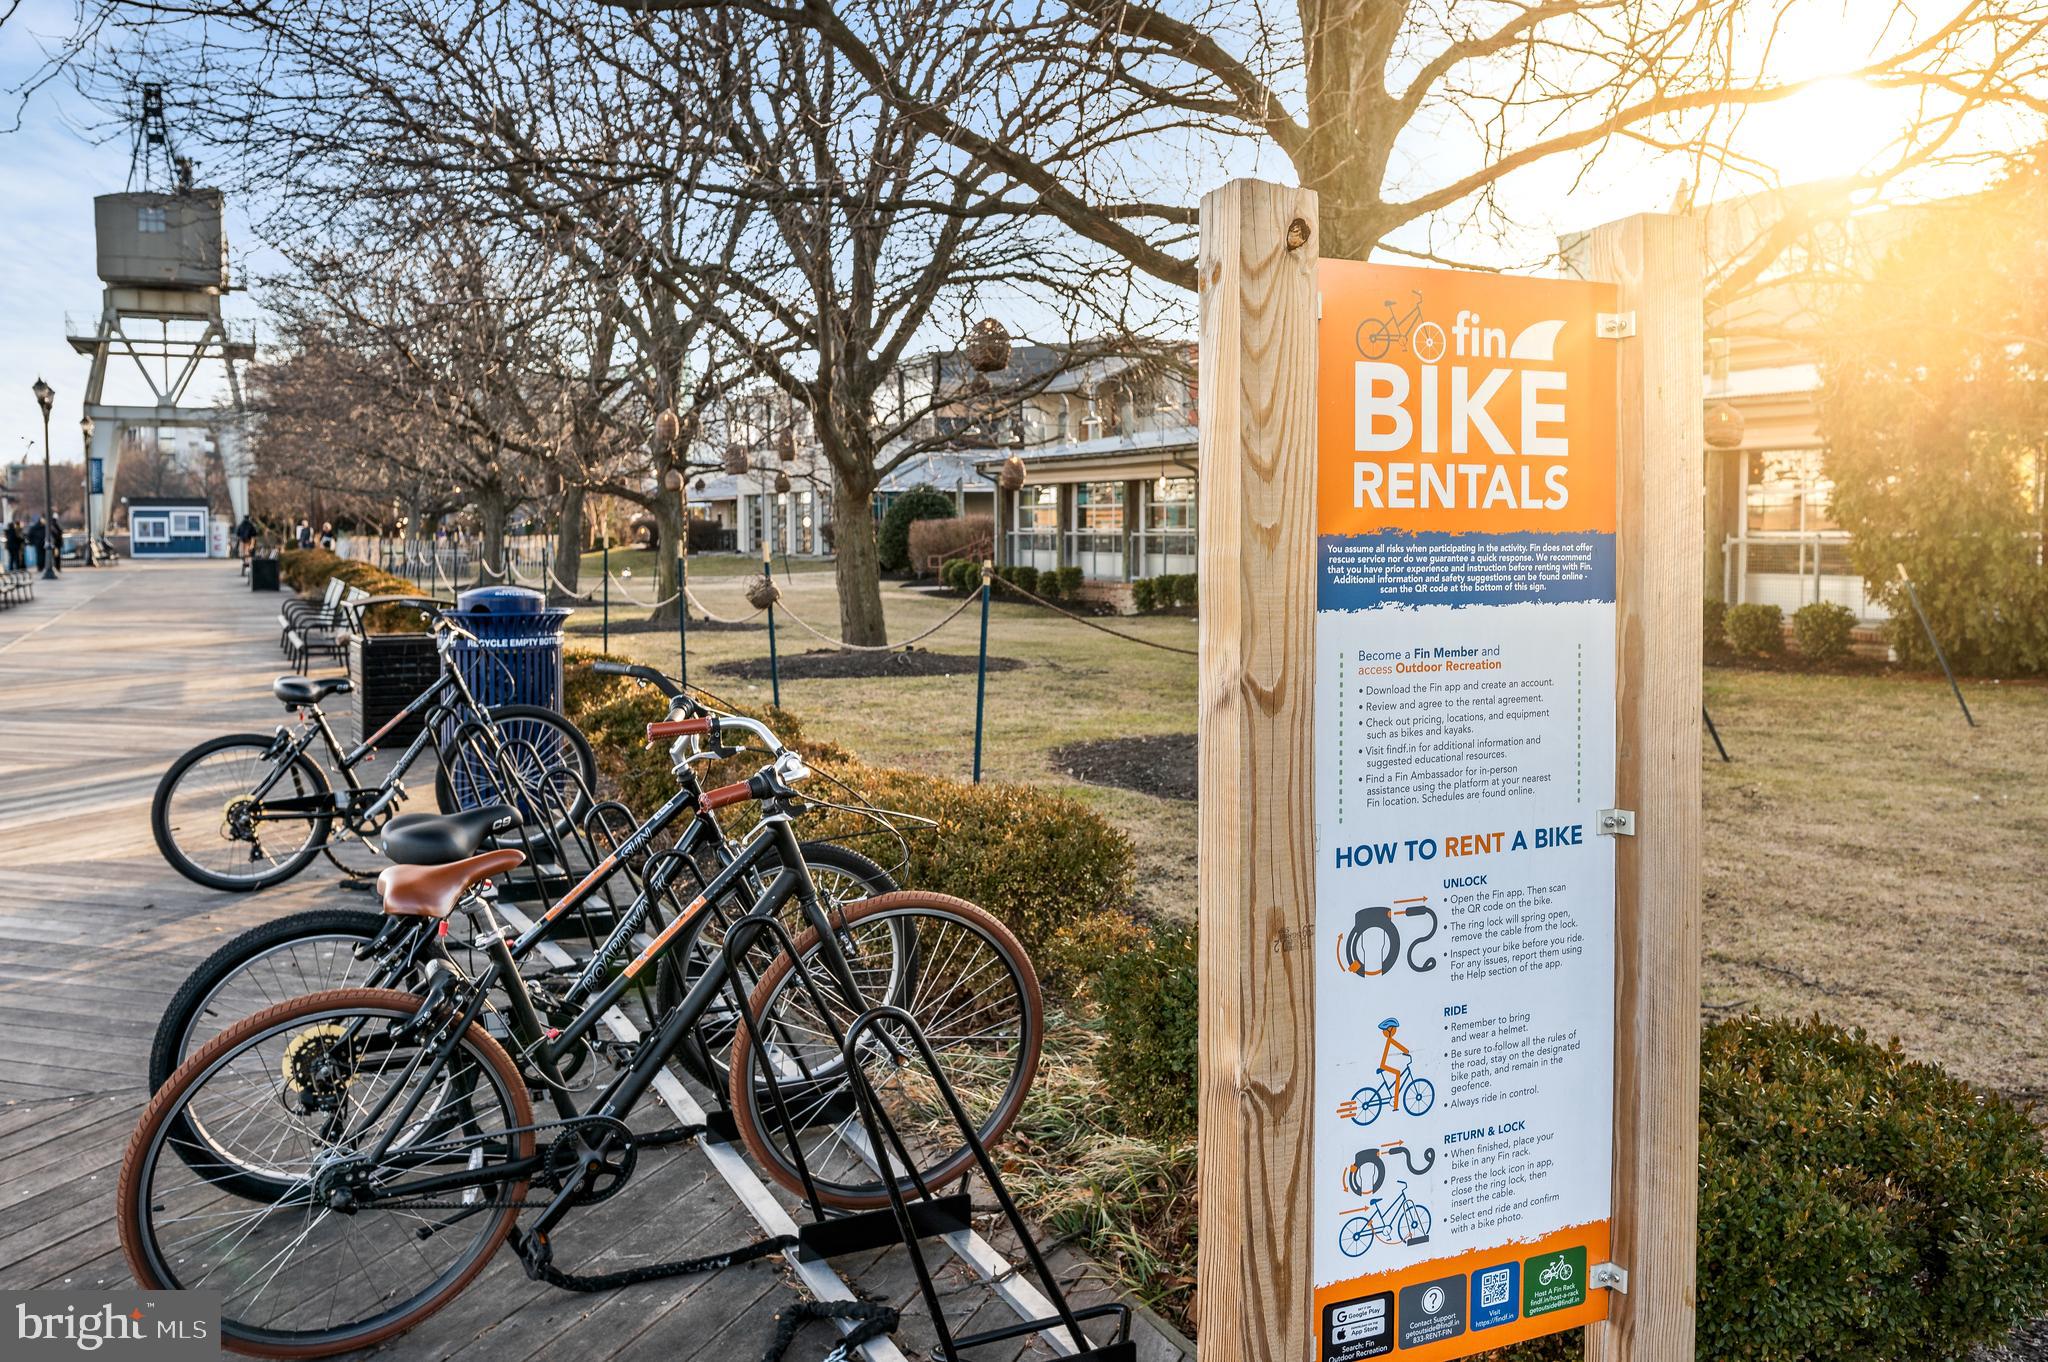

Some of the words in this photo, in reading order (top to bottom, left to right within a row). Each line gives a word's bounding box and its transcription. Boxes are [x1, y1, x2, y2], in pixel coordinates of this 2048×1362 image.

[1452, 310, 1506, 358] fin
[1354, 361, 1569, 456] BIKE
[1353, 461, 1569, 511] RENTALS
[1327, 544, 1342, 553] You
[1375, 544, 1384, 552] all
[1386, 544, 1404, 552] risks
[1405, 544, 1427, 552] when
[1428, 544, 1475, 555] participating
[1477, 544, 1484, 552] in
[1486, 543, 1498, 552] the
[1500, 543, 1527, 554] activity.
[1529, 543, 1540, 552] Fin
[1542, 543, 1560, 551] does
[1575, 543, 1592, 551] offer
[1357, 554, 1385, 563] service
[1403, 554, 1413, 562] do
[1429, 555, 1468, 565] guarantee
[1476, 553, 1496, 564] quick
[1498, 555, 1534, 564] response.
[1535, 553, 1548, 561] We
[1549, 552, 1591, 561] recommend
[1399, 584, 1412, 593] the
[1414, 584, 1427, 593] QR
[1429, 584, 1448, 592] code
[1459, 583, 1472, 592] the
[1474, 583, 1502, 592] bottom
[1504, 583, 1512, 591] of
[1514, 582, 1527, 591] this
[1529, 582, 1546, 593] sign.
[510, 637, 538, 647] EMPTY
[539, 636, 564, 646] BOTTL
[1358, 650, 1401, 661] Become
[1404, 651, 1410, 660] a
[1414, 648, 1430, 659] Fin
[1434, 646, 1478, 658] Member
[1481, 645, 1499, 657] and
[1358, 666, 1392, 675] access
[1395, 661, 1442, 673] Outdoor
[1445, 659, 1501, 671] Recreation
[1366, 684, 1410, 695] Download
[1412, 683, 1427, 693] the
[1429, 682, 1441, 692] Fin
[1444, 684, 1460, 694] app
[1463, 680, 1478, 690] and
[1480, 680, 1506, 690] create
[1520, 678, 1553, 688] account.
[1365, 717, 1393, 728] Check
[1395, 717, 1410, 726] out
[1412, 714, 1444, 728] pricing,
[1446, 712, 1486, 723] locations,
[1488, 710, 1503, 720] and
[1505, 709, 1549, 722] equipment
[1366, 729, 1386, 739] such
[1400, 727, 1423, 737] bikes
[1425, 726, 1441, 736] and
[1443, 724, 1473, 737] kayaks.
[1365, 746, 1384, 756] Visit
[1386, 744, 1416, 754] findf.in
[1418, 743, 1430, 752] for
[1433, 739, 1474, 751] additional
[1477, 737, 1523, 749] information
[1525, 735, 1540, 745] and
[1366, 755, 1412, 770] suggested
[1414, 752, 1463, 764] educational
[1465, 751, 1506, 761] resources.
[621, 826, 652, 858] SUN
[1336, 842, 1397, 868] HOW
[1404, 838, 1436, 862] TO
[1445, 832, 1504, 858] RENT
[1511, 830, 1527, 851] A
[1535, 824, 1582, 849] BIKE
[1443, 875, 1487, 889] UNLOCK
[1450, 894, 1473, 906] Open
[1476, 892, 1489, 902] the
[1492, 890, 1504, 900] Fin
[1506, 890, 1524, 900] app.
[1527, 886, 1546, 896] Then
[1548, 885, 1566, 894] scan
[1450, 921, 1465, 931] The
[1468, 919, 1484, 930] ring
[1486, 916, 1503, 927] lock
[1505, 914, 1518, 925] will
[1520, 912, 1545, 925] spring
[1547, 910, 1570, 922] open,
[582, 872, 668, 992] BOARDWAK
[1444, 1005, 1467, 1017] RIDE
[1450, 1017, 1496, 1031] Remember
[1498, 1017, 1506, 1025] to
[1509, 1013, 1530, 1024] bring
[1451, 1032, 1466, 1043] and
[1468, 1031, 1488, 1041] wear
[1498, 1024, 1528, 1036] helmet.
[1450, 1081, 1491, 1096] geofence.
[1450, 1097, 1479, 1108] Always
[1481, 1092, 1497, 1103] ride
[1499, 1091, 1506, 1100] in
[1508, 1085, 1538, 1099] control.
[1444, 1128, 1484, 1144] RETURN
[1487, 1126, 1494, 1137] &
[1498, 1121, 1525, 1135] LOCK
[1450, 1211, 1475, 1224] Select
[1477, 1206, 1492, 1218] end
[1495, 1203, 1510, 1214] ride
[1512, 1198, 1528, 1211] and
[1529, 1194, 1559, 1207] confirm
[1450, 1222, 1468, 1234] with
[1477, 1218, 1494, 1229] bike
[1497, 1214, 1523, 1228] photo.
[1534, 1290, 1547, 1298] Host
[1563, 1283, 1575, 1291] Rack
[1410, 1319, 1432, 1329] Contact
[1434, 1313, 1456, 1324] Support
[1413, 1328, 1452, 1344] 833-RENT-FIN
[1329, 1353, 1355, 1362] Outdoor
[1356, 1345, 1388, 1357] Recreation
[1342, 1342, 1364, 1353] Search:
